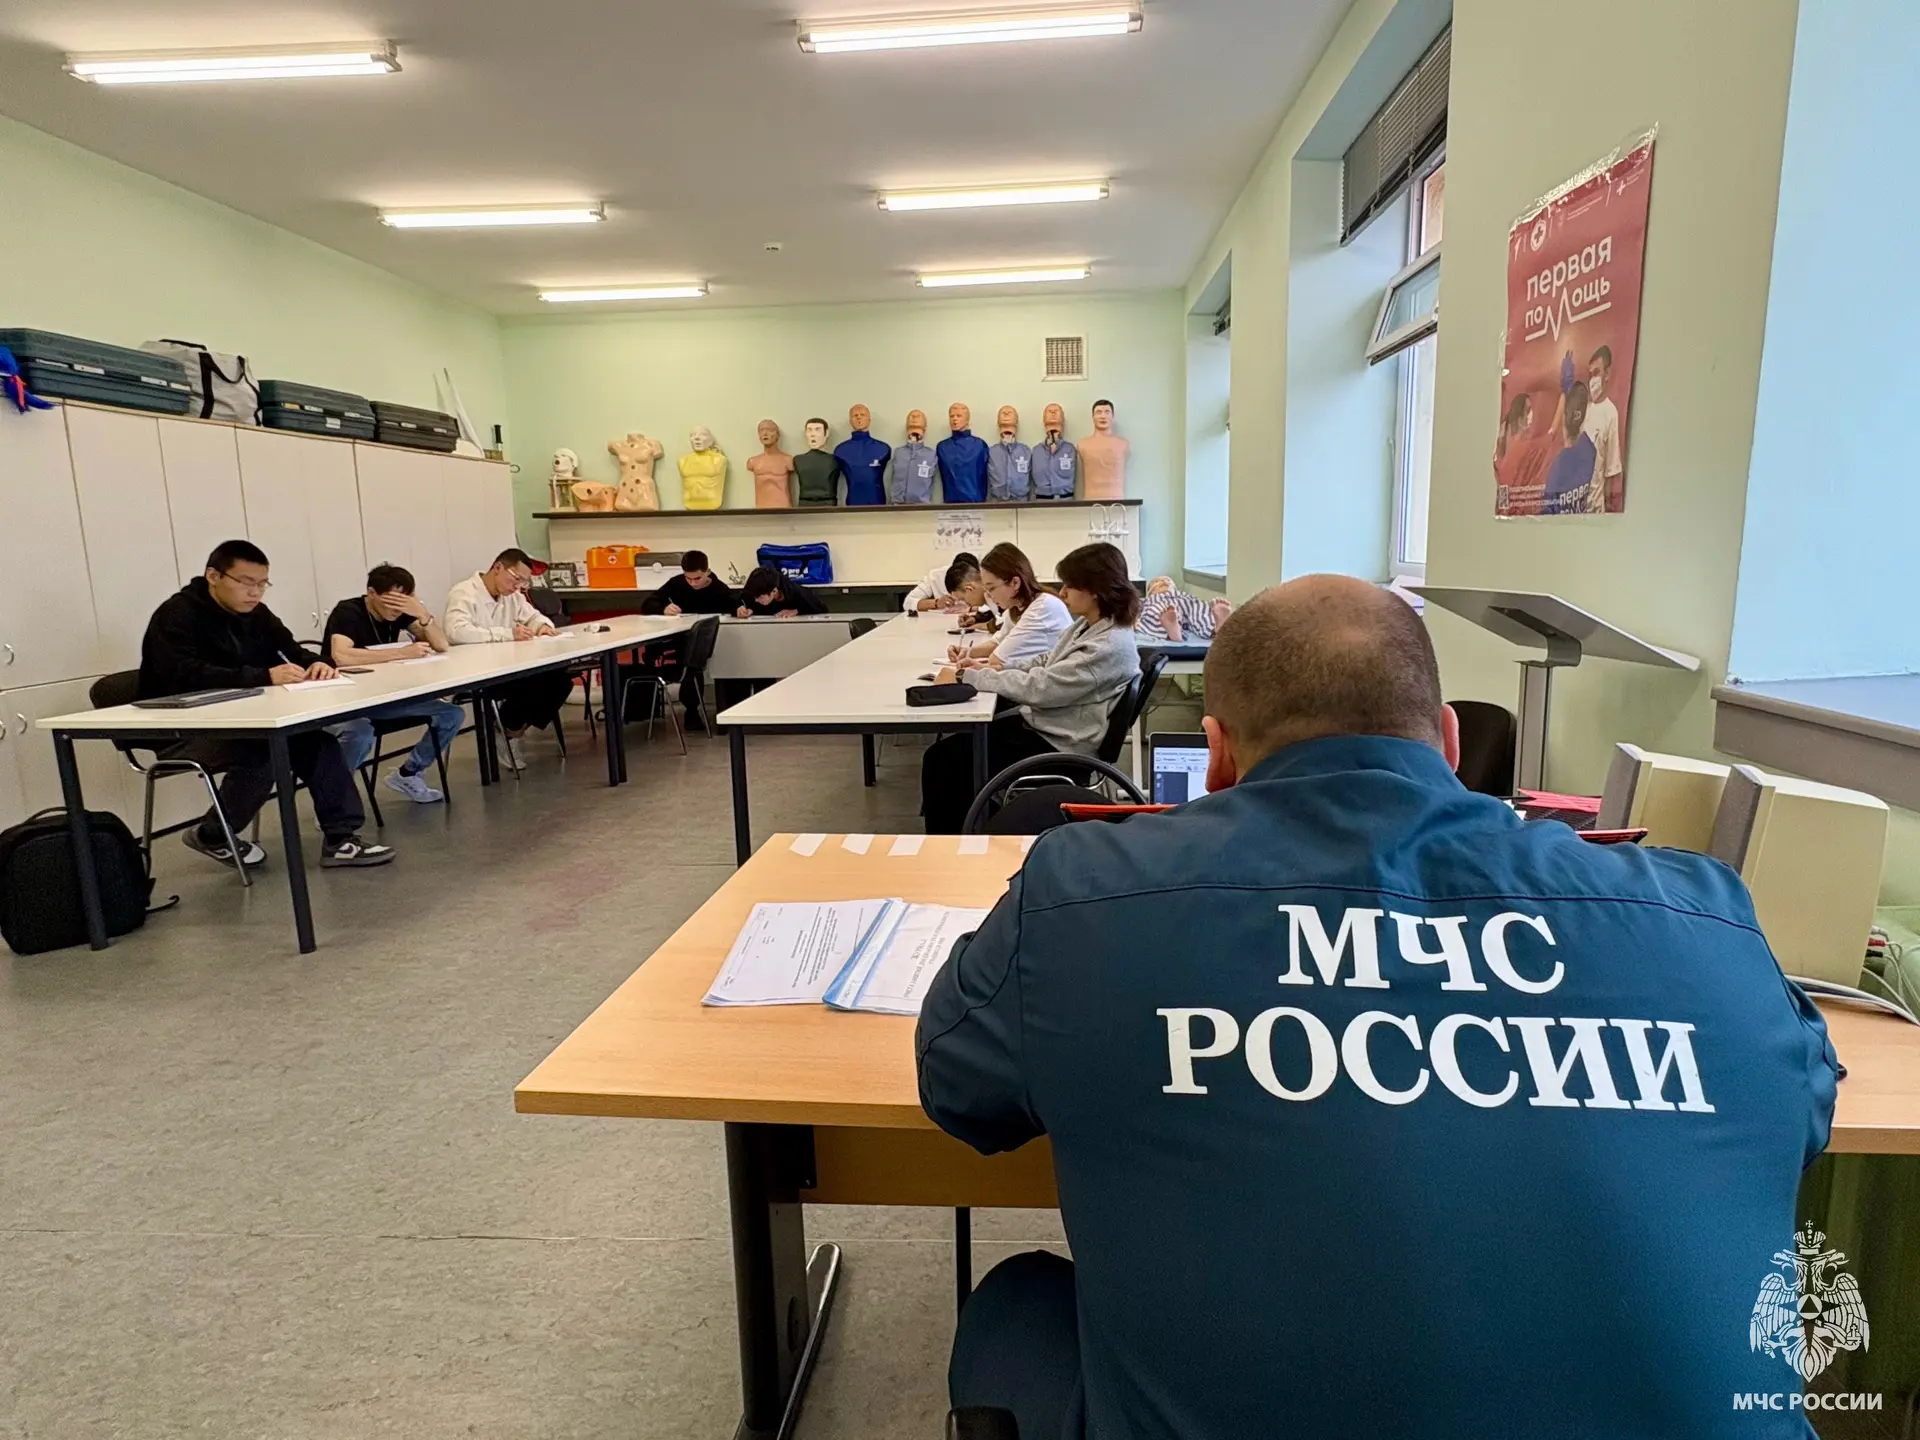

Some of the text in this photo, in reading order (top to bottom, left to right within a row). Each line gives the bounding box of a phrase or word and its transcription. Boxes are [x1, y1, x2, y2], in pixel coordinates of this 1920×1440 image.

[1526, 235, 1612, 302] первая
[1277, 904, 1565, 994] МЧС
[1156, 1006, 1716, 1113] РОССИИ
